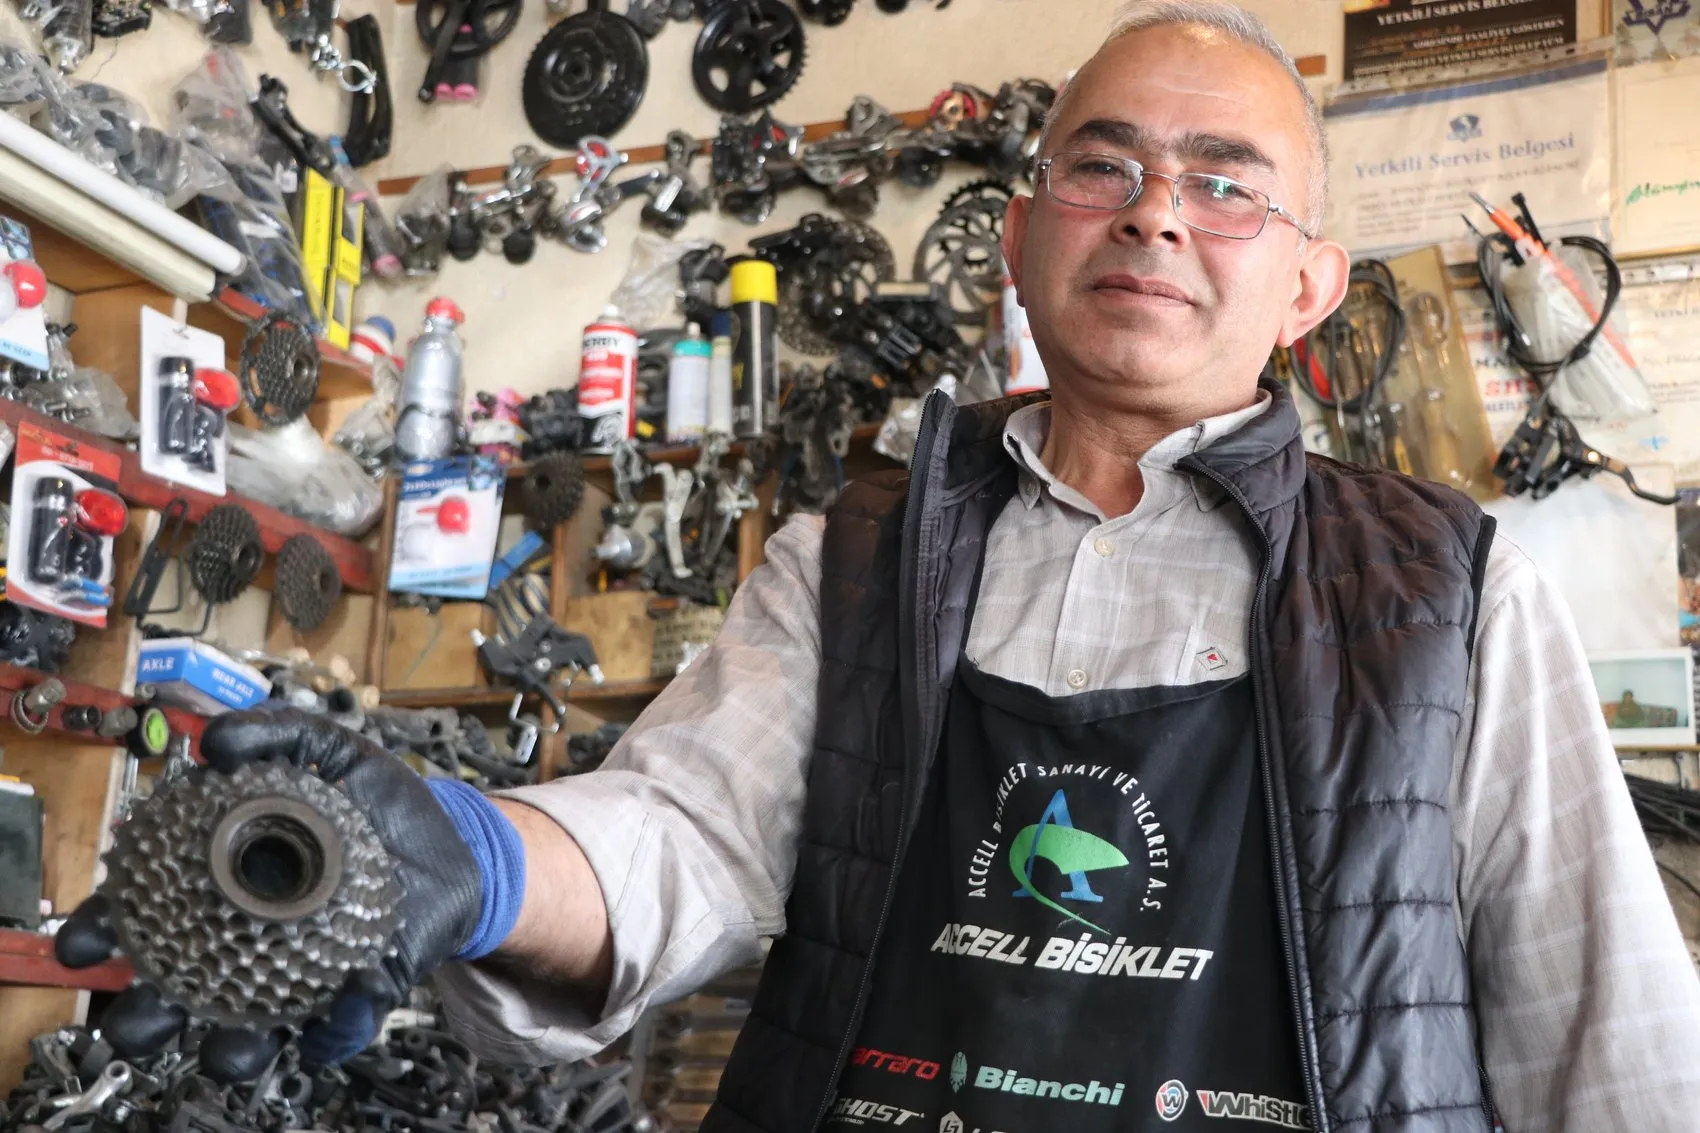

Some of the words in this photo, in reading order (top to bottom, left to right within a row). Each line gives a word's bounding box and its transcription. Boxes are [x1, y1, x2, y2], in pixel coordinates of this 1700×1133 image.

[1355, 155, 1422, 179] Yetkili
[1429, 149, 1491, 170] Servis
[1499, 132, 1575, 160] Belgesi
[142, 656, 175, 672] AXLE
[968, 839, 999, 898] ACCELL
[1112, 771, 1138, 795] VE
[930, 922, 1031, 965] ACCELL
[1034, 932, 1214, 981] BİSİKLET
[974, 1065, 1126, 1106] Bianchi
